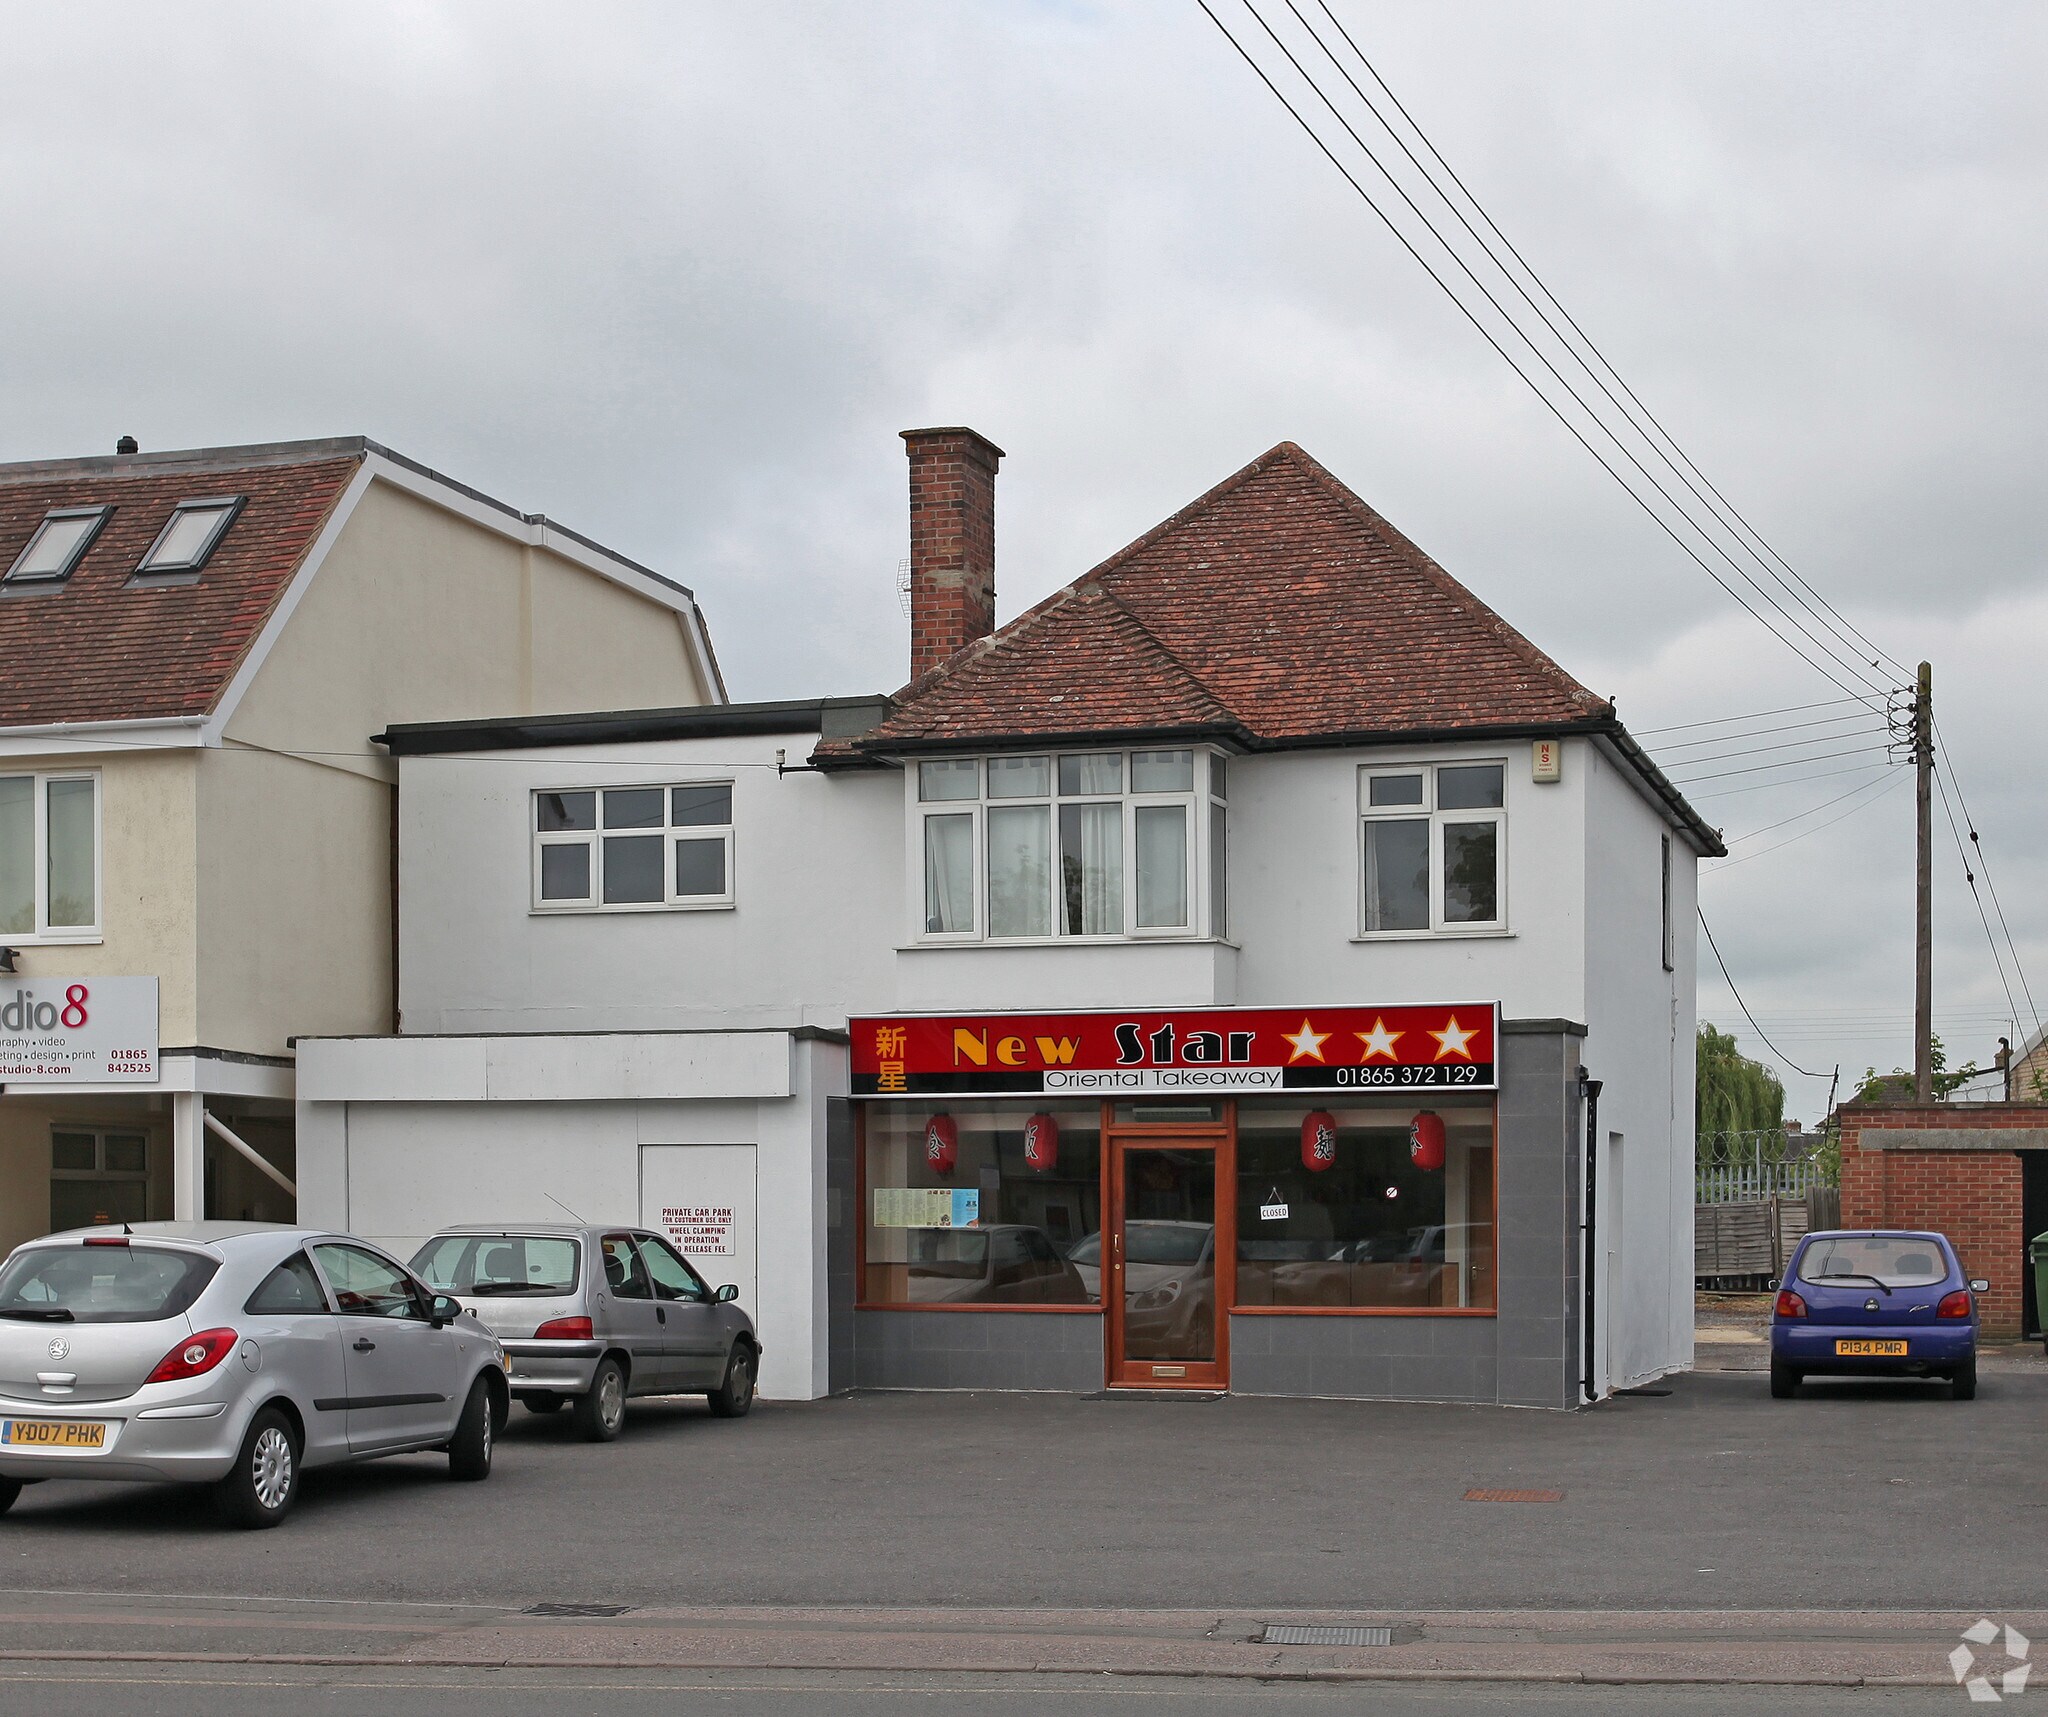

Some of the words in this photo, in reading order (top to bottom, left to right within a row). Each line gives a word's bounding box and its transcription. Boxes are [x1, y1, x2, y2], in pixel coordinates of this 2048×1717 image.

[0, 989, 58, 1031] dio
[0, 1036, 30, 1048] raphy
[38, 1037, 66, 1047] video
[953, 1027, 1081, 1066] New
[1114, 1022, 1256, 1065] Star
[30, 1050, 64, 1062] design
[71, 1050, 96, 1061] print
[111, 1049, 148, 1060] 01865
[875, 1026, 908, 1091] 新星
[107, 1063, 152, 1073] 842525
[1045, 1070, 1145, 1088] Oriental
[1152, 1067, 1281, 1087] Takeaway
[1336, 1067, 1396, 1085] 01865
[1401, 1066, 1436, 1084] 372
[1443, 1065, 1478, 1083] 129
[662, 1208, 692, 1216] PRIVATE
[694, 1208, 710, 1216] CAR
[712, 1208, 732, 1216] PARK
[1262, 1208, 1287, 1217] CLOSED
[669, 1227, 690, 1235] WHEEL
[692, 1227, 726, 1235] CLAMPING
[674, 1236, 682, 1244] IN
[684, 1236, 720, 1244] OPERATION
[684, 1245, 712, 1253] RELEASE
[714, 1245, 726, 1253] FEE
[1875, 1342, 1902, 1353] PMR
[16, 1423, 62, 1441] YD07
[65, 1424, 102, 1442] PHK
